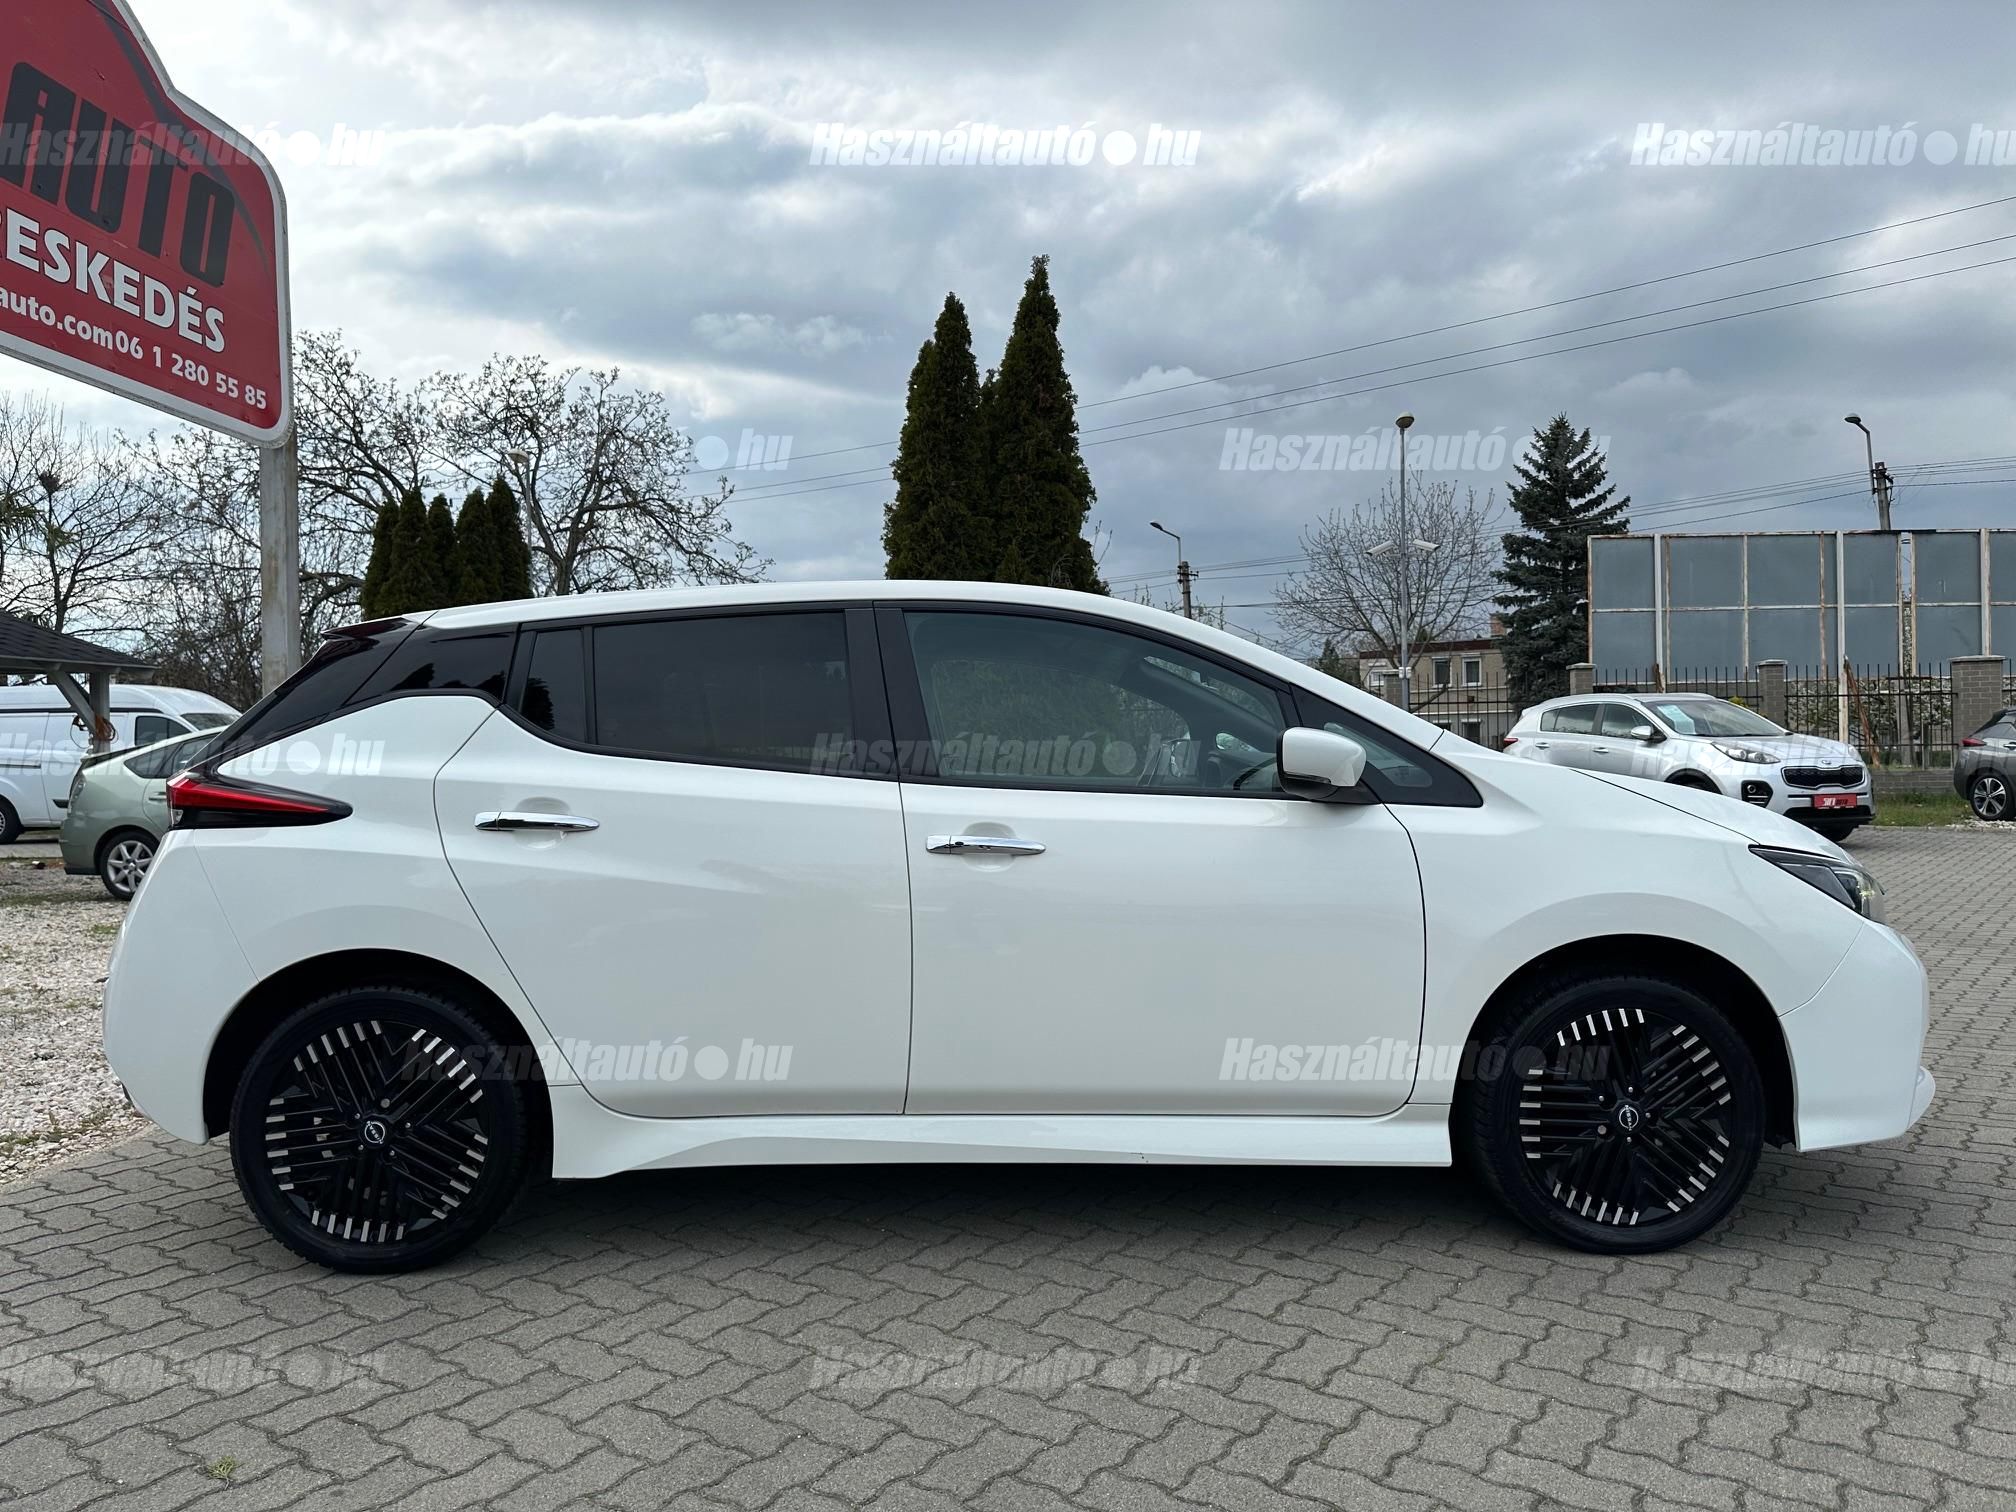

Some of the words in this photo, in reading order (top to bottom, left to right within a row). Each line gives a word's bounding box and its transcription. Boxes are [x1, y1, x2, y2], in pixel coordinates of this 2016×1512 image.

[0, 62, 235, 287] AUTO
[0, 207, 225, 353] ESKEDÉS
[153, 345, 162, 368] 1
[171, 353, 209, 386] 280
[216, 371, 239, 399] 55
[245, 383, 267, 411] 85
